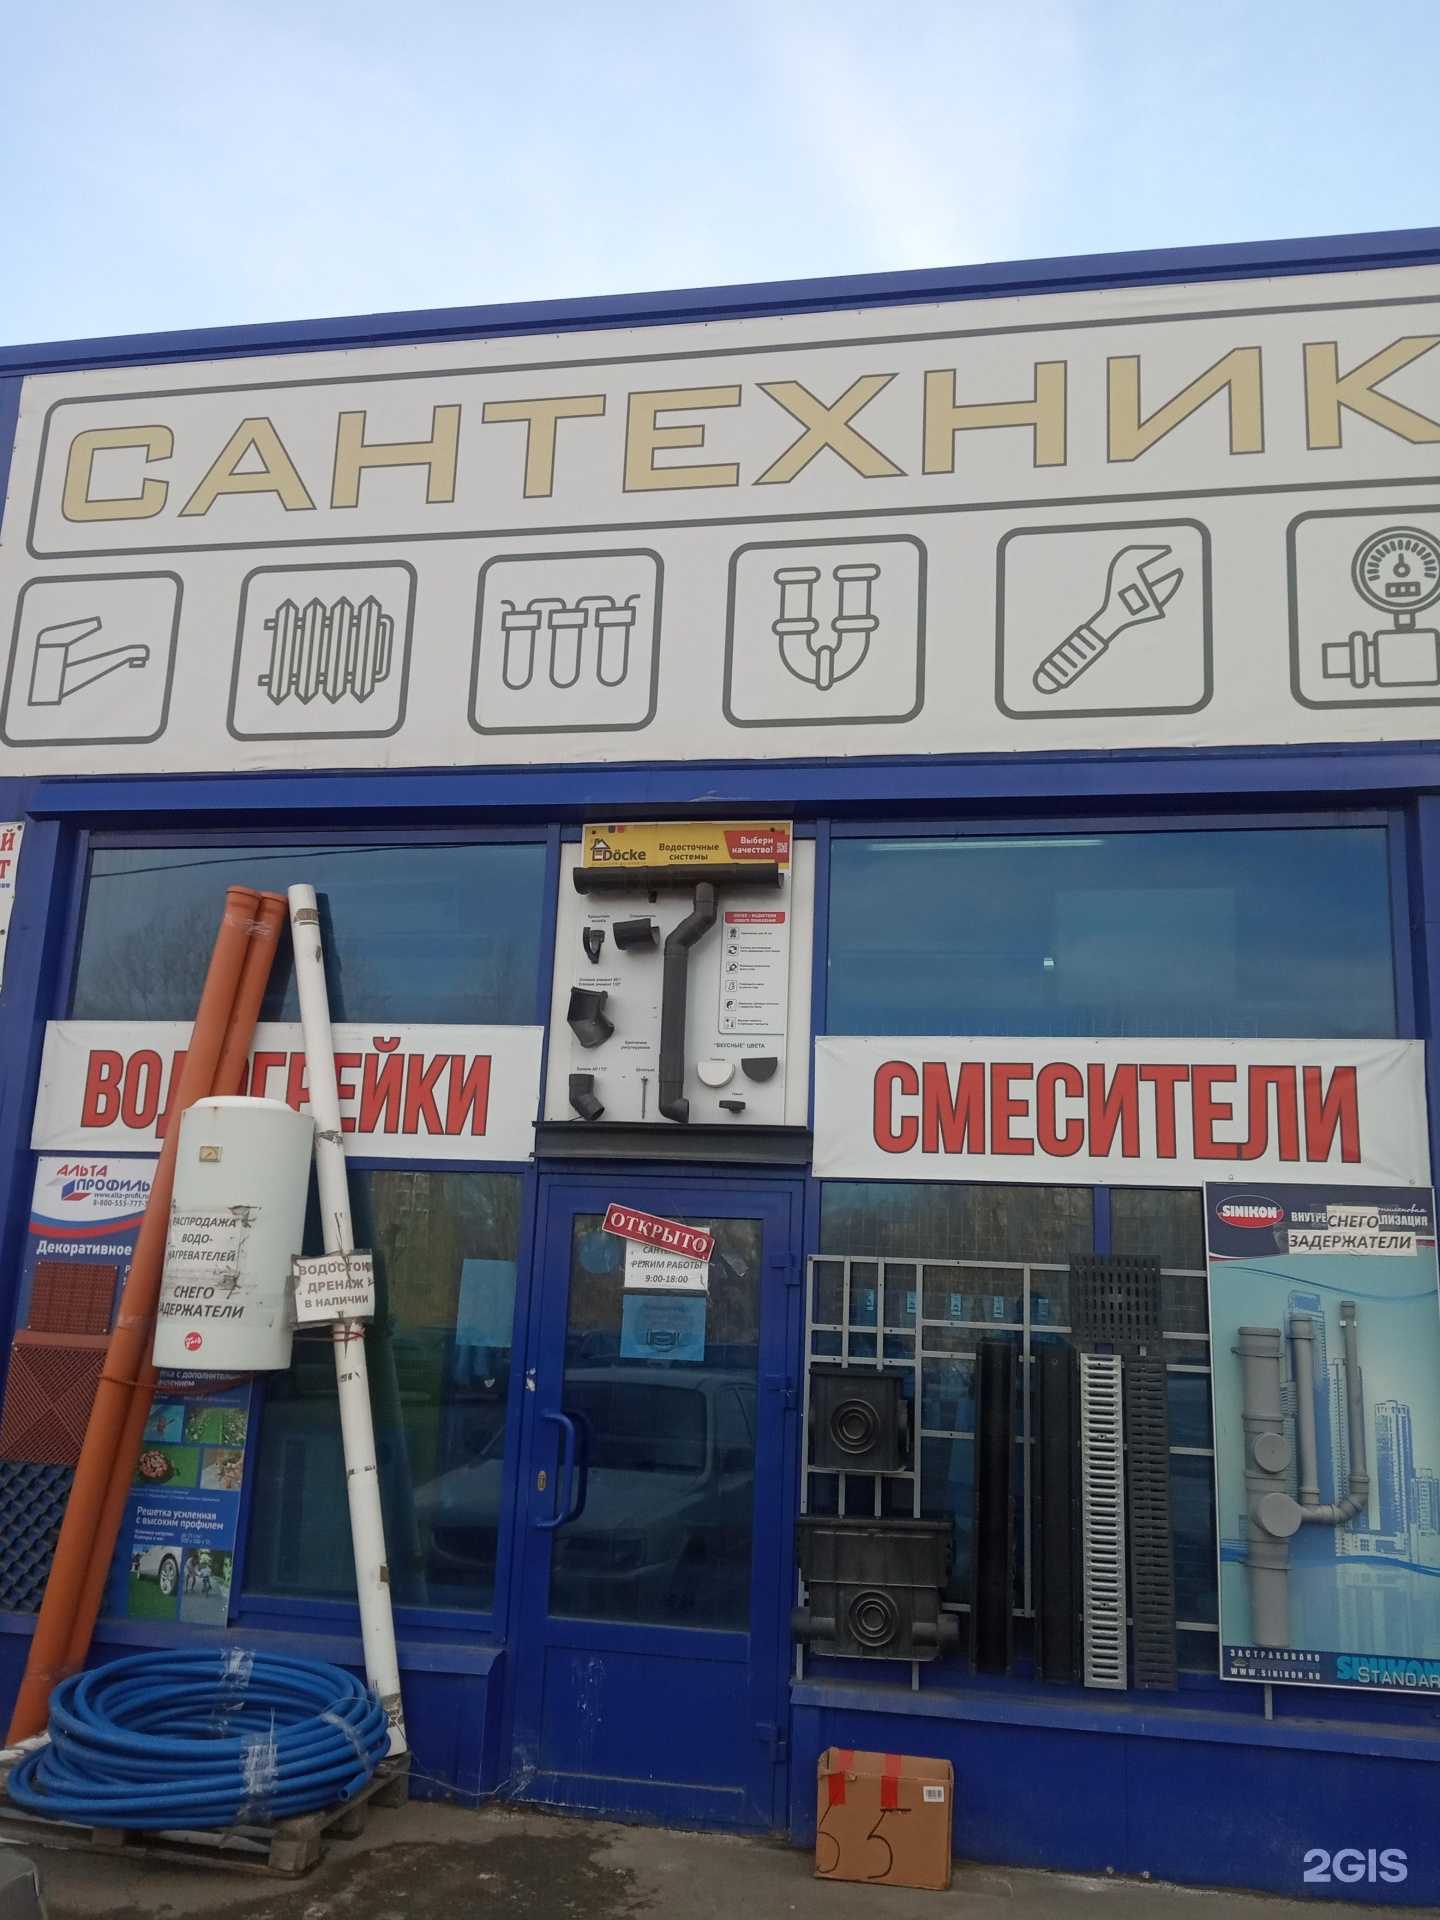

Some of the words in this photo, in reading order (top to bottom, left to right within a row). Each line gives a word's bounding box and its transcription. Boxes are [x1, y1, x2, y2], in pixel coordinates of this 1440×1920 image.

[61, 335, 1440, 522] САНТЕХНИК
[659, 842, 719, 852] Водосточные
[740, 836, 773, 845] Выбери
[603, 848, 646, 861] Döcke
[669, 853, 708, 861] системы
[732, 846, 773, 854] качество!
[80, 1037, 492, 1138] ВОГЕЙКИ
[873, 1060, 1361, 1164] СМЕСИТЕЛИ
[56, 1164, 108, 1177] АЛЬТА
[76, 1178, 151, 1192] ПРОФИЛЬ
[1222, 1205, 1278, 1219] SINIKON
[1291, 1212, 1327, 1222] ВНУТРЕ
[1379, 1214, 1428, 1227] ЛИЗАЦИЯ
[1328, 1214, 1379, 1229] СНЕГО
[610, 1212, 708, 1253] ОТКРЫТО
[182, 1234, 213, 1246] ВОДО-
[1289, 1235, 1412, 1250] ЗАДЕРЖАТЕЛИ
[36, 1240, 133, 1257] Декоративное
[632, 1260, 665, 1269] РЕЖИМ
[666, 1261, 703, 1270] РАБОТЫ
[645, 1275, 689, 1283] 9:00-18:00
[174, 1286, 215, 1299] СНЕГО
[308, 1279, 364, 1294] ДРЕНАЖ
[304, 1299, 312, 1308] В
[315, 1295, 369, 1308] НАЛИЧИИ
[158, 1302, 244, 1319] АДЕРЖАТЕЛИ
[137, 1506, 171, 1518] Решетка
[173, 1510, 217, 1521] усиленная
[142, 1517, 178, 1527] высоким
[180, 1519, 224, 1530] профилем
